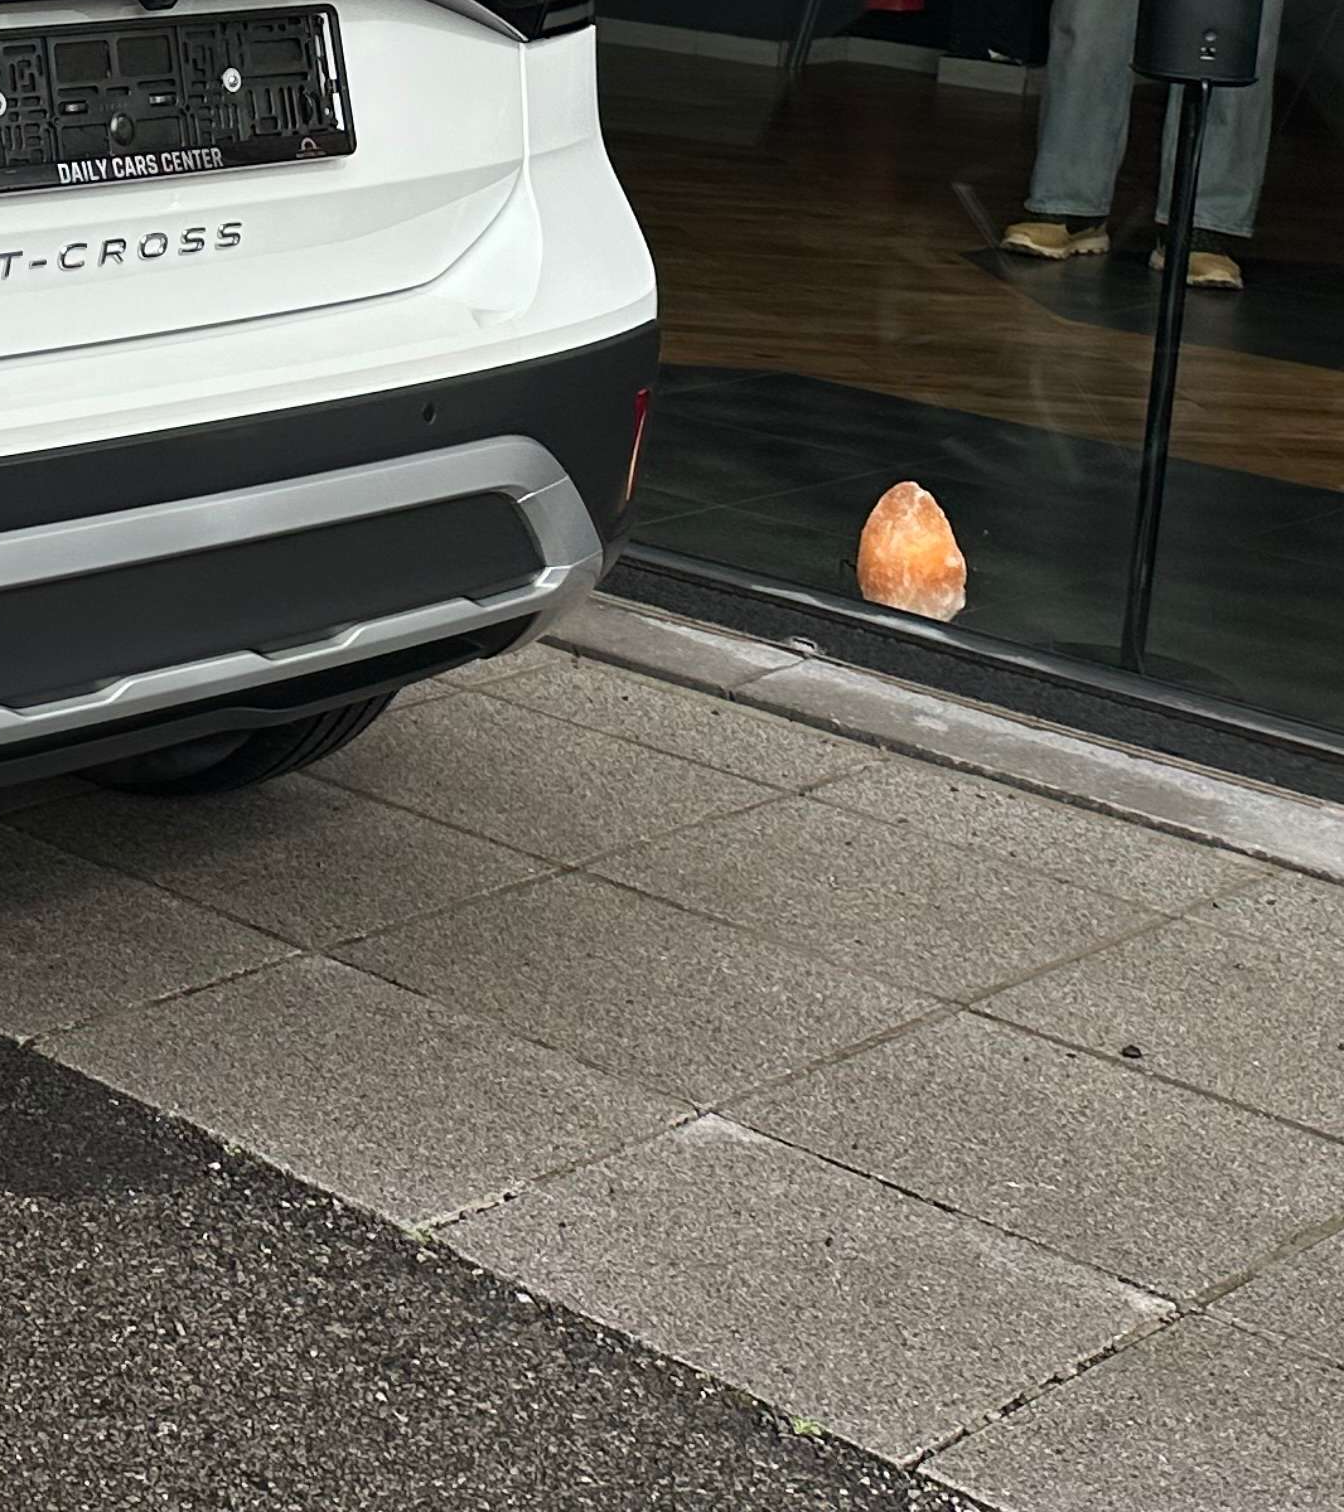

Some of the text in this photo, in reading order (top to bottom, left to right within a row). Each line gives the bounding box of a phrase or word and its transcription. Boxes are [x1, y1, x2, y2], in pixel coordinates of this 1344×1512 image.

[56, 146, 224, 185] DAILY CARS CENTER
